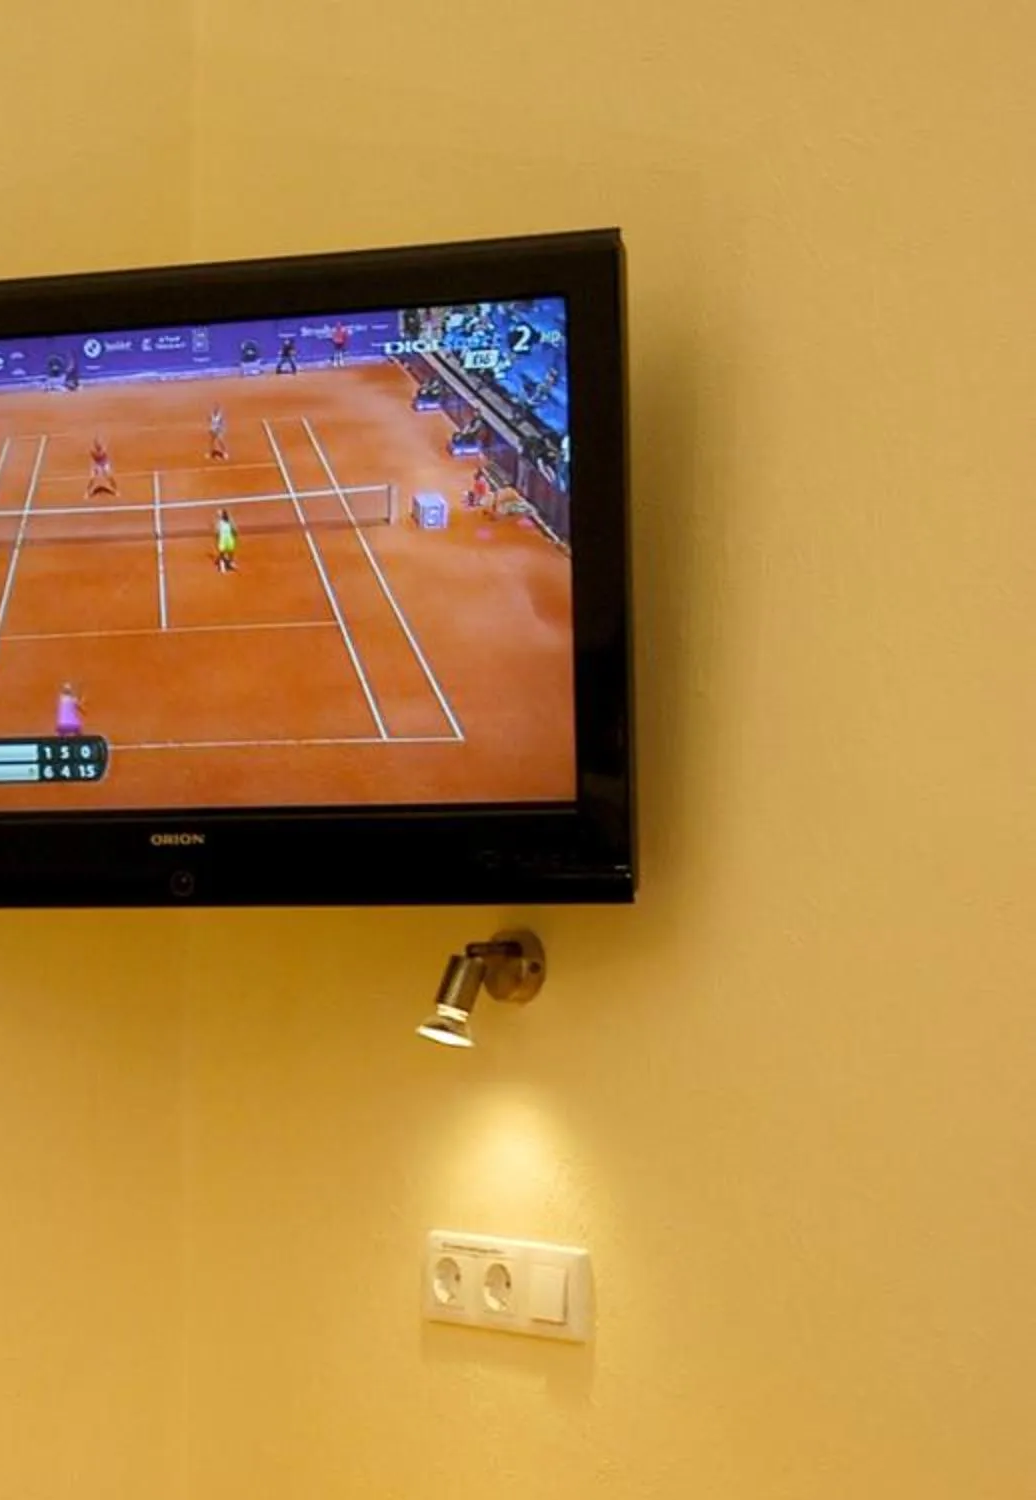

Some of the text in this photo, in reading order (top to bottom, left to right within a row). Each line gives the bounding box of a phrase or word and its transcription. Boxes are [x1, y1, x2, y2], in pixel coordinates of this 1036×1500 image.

[512, 325, 532, 351] 2
[43, 745, 92, 760] 1 5 0
[43, 764, 96, 780] 6 4 15
[150, 833, 206, 847] ORION
